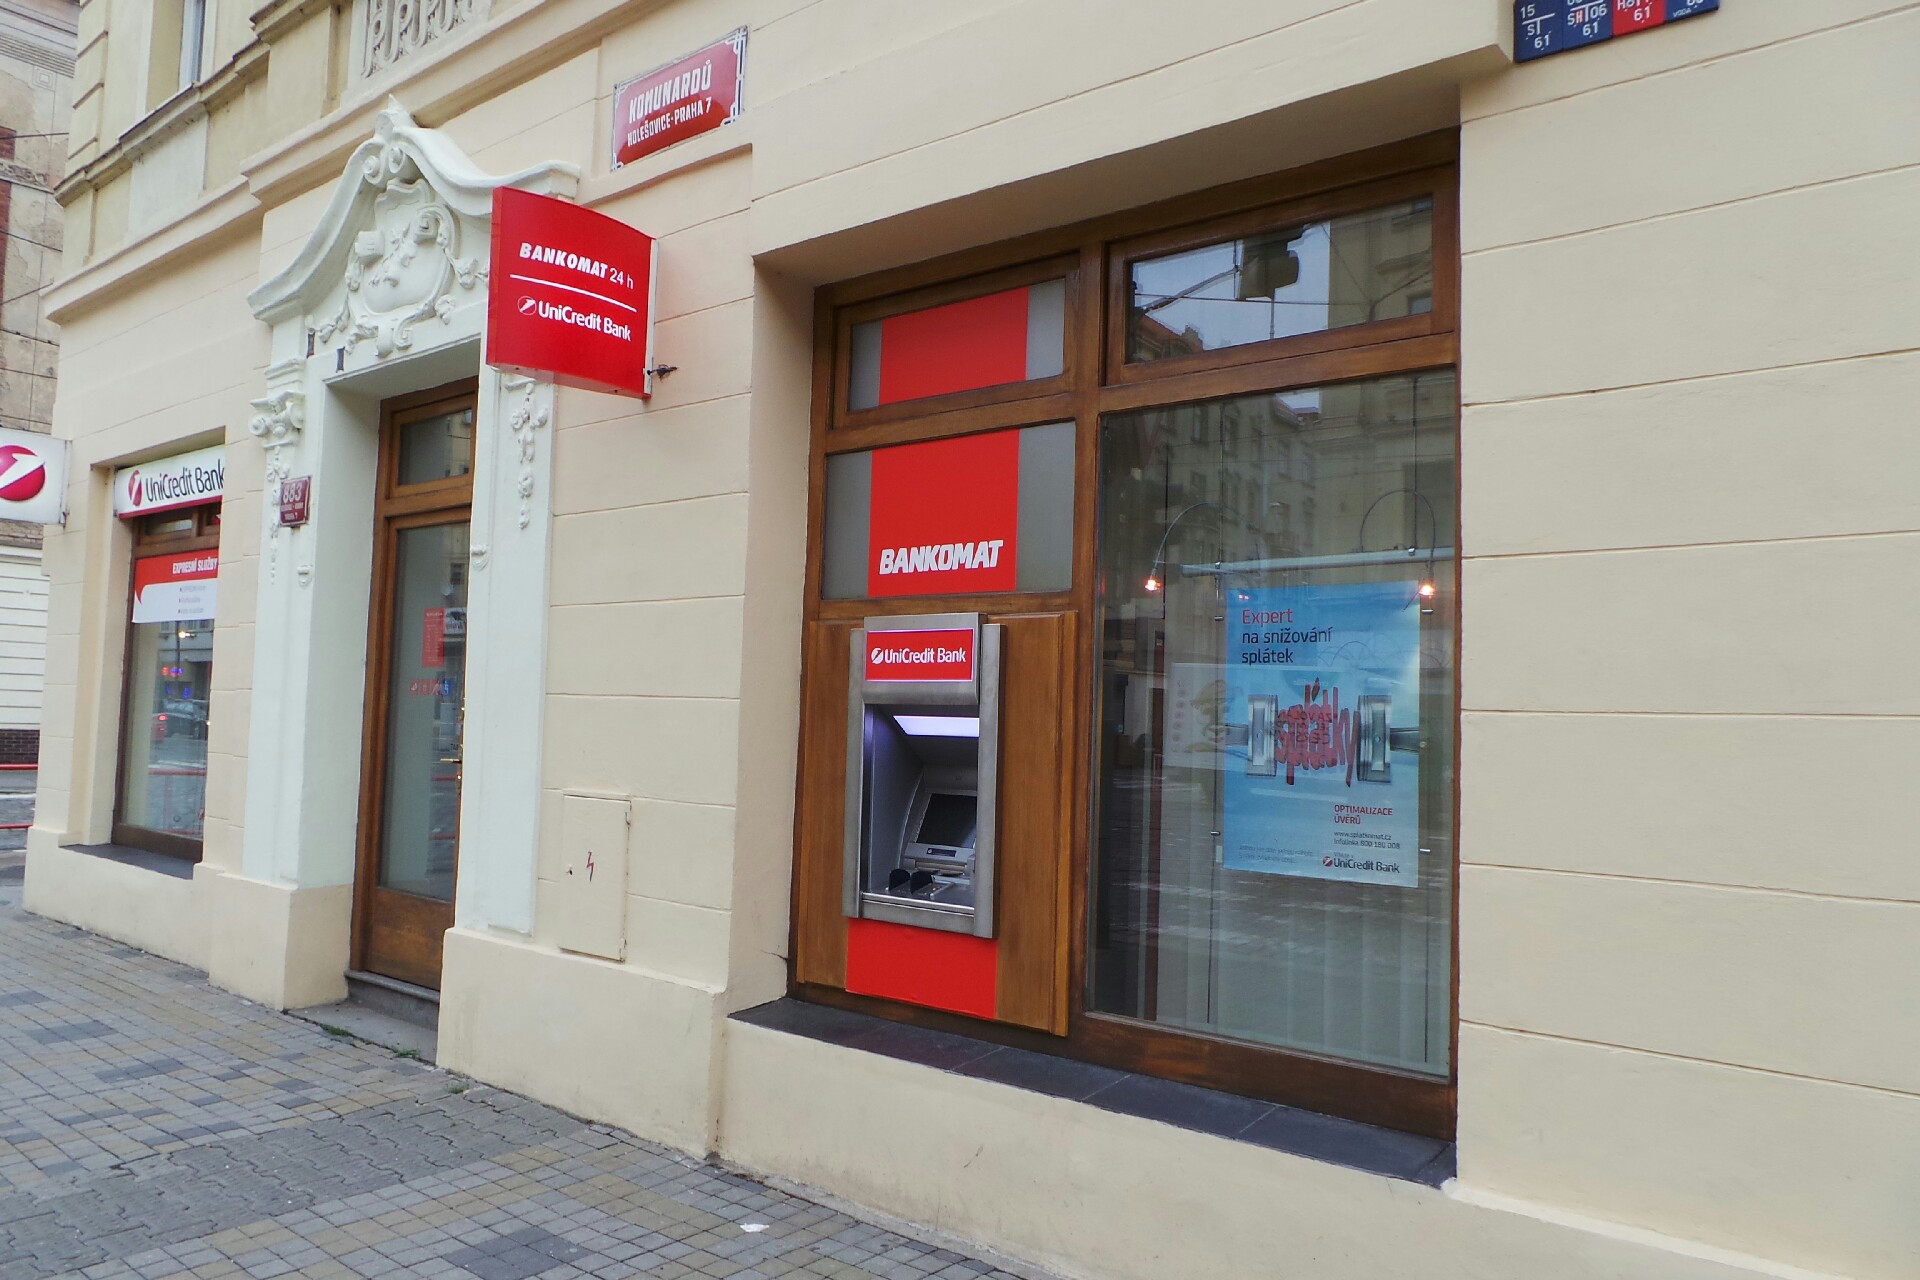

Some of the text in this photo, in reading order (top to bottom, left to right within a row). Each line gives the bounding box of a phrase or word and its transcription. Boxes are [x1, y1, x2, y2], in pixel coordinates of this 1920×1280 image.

[1520, 3, 1536, 19] 15
[628, 59, 712, 124] KOMUNARDŮ
[705, 96, 712, 114] 7
[519, 242, 634, 290] BANKOMAT 24 h
[538, 300, 631, 341] UniCredit Bank
[145, 458, 224, 502] UniCredit Bank
[283, 482, 302, 503] 883
[879, 539, 1004, 575] BANKOMAT
[1242, 608, 1293, 627] Expert
[1242, 626, 1334, 644] na snižování
[884, 647, 966, 664] UniCredit Bank
[1241, 647, 1294, 667] splátek
[1334, 804, 1393, 816] OPTIMALIZACE
[1334, 813, 1361, 825] ÚVĚRŮ
[1360, 839, 1373, 847] 800
[1333, 857, 1400, 874] UniCredit Bank
